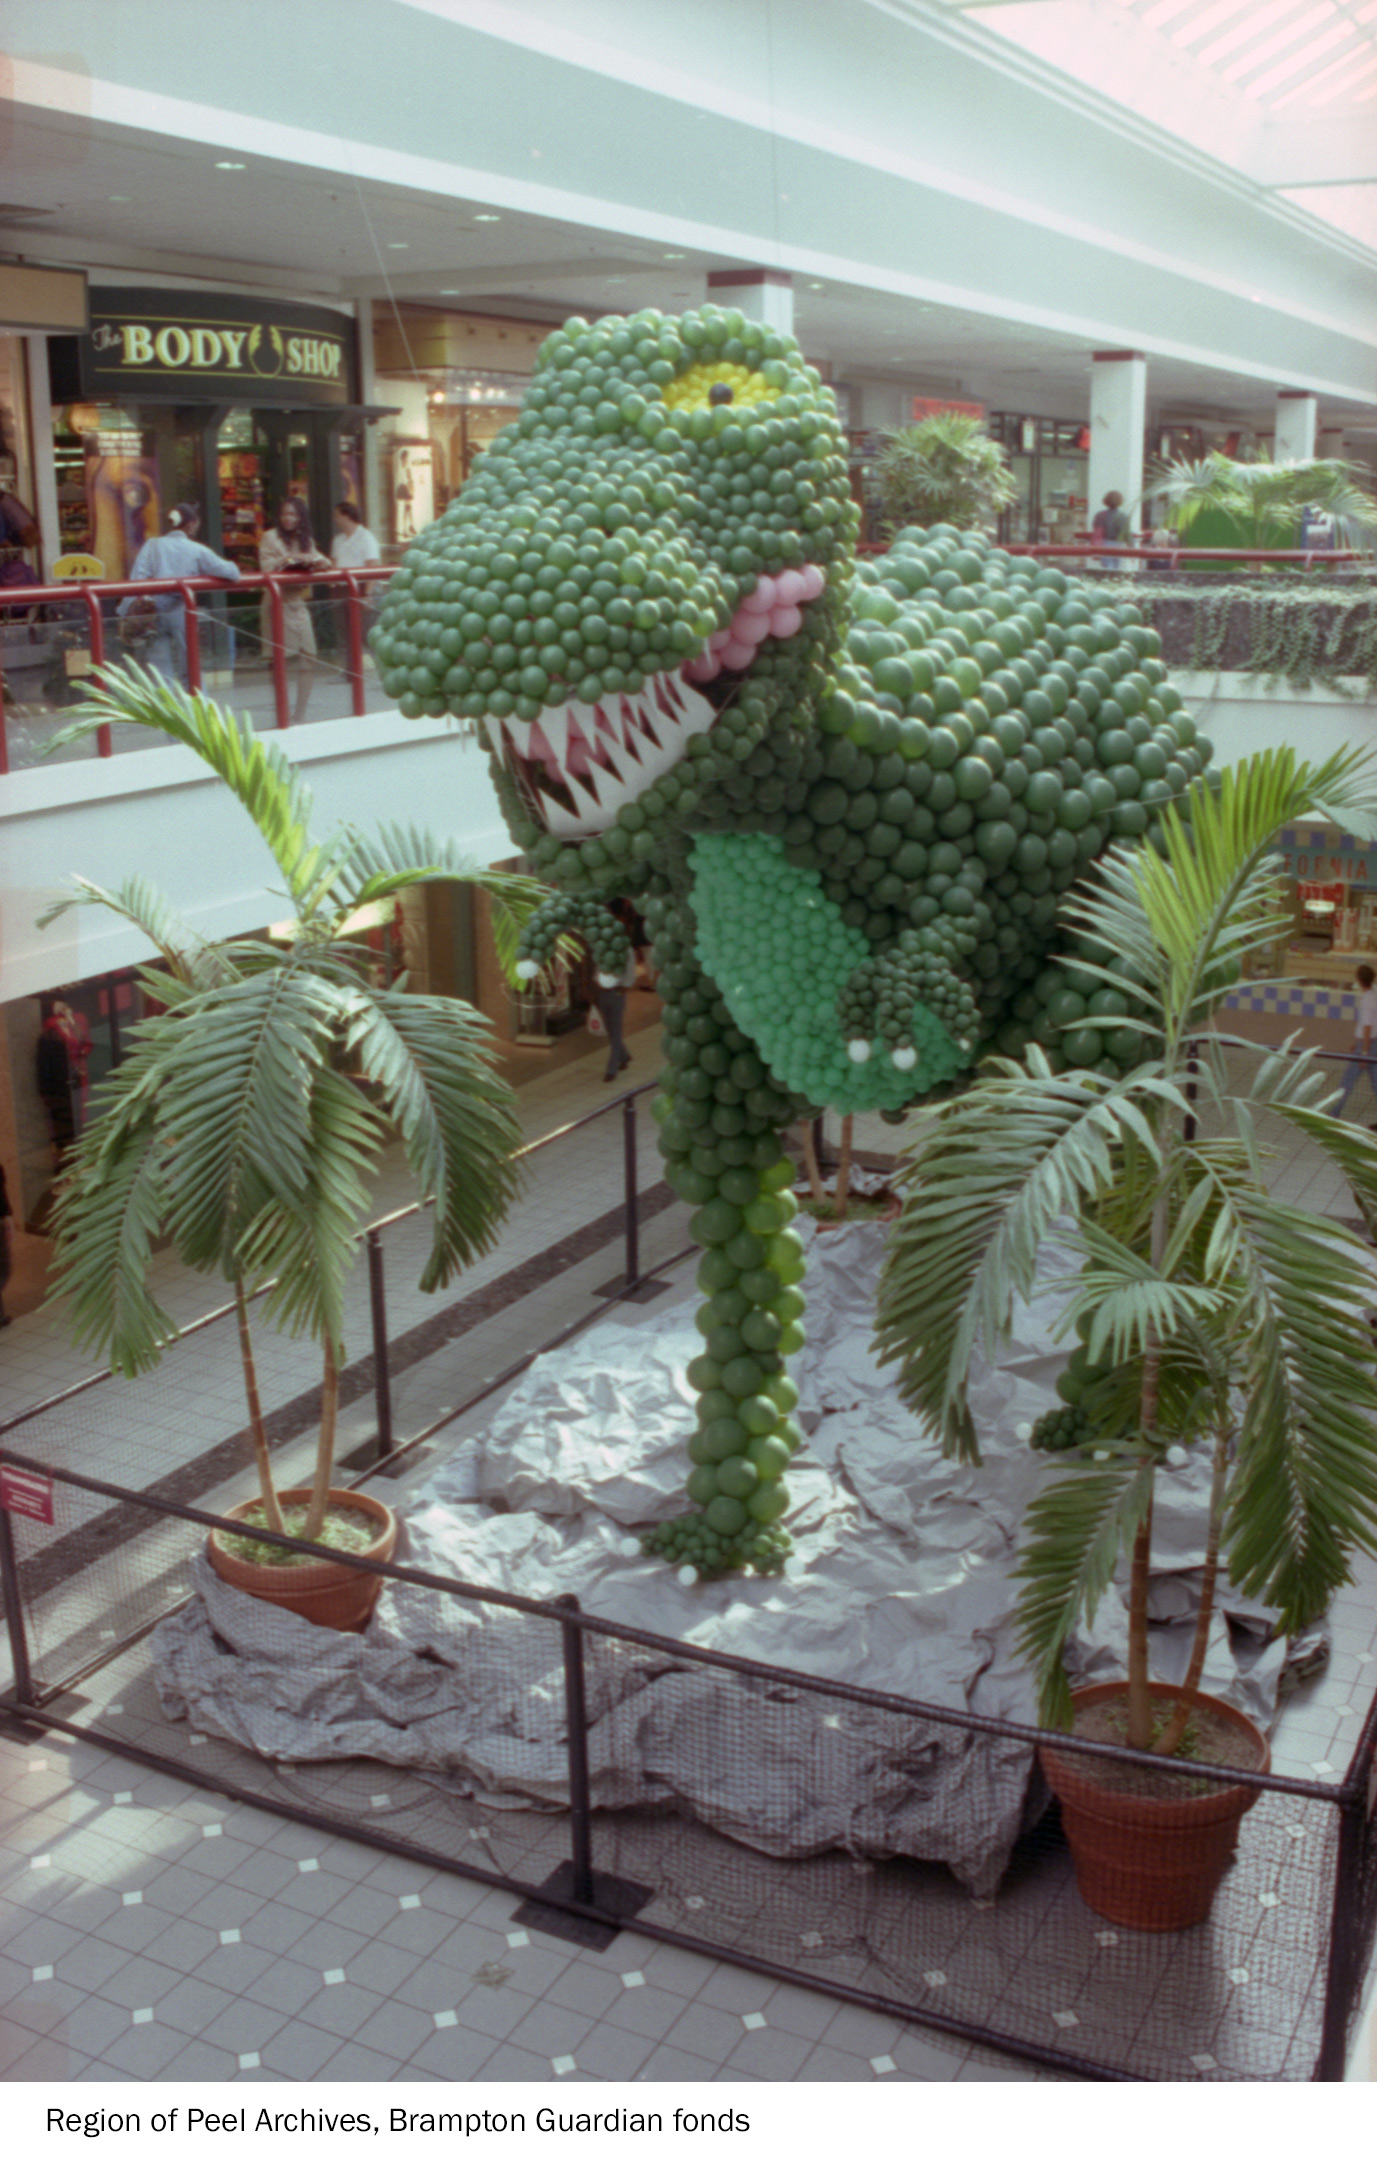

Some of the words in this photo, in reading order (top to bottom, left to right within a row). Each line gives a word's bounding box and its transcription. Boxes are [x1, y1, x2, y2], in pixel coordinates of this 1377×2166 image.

[92, 324, 122, 351] The
[120, 325, 247, 368] BODY
[287, 337, 341, 377] SHOP
